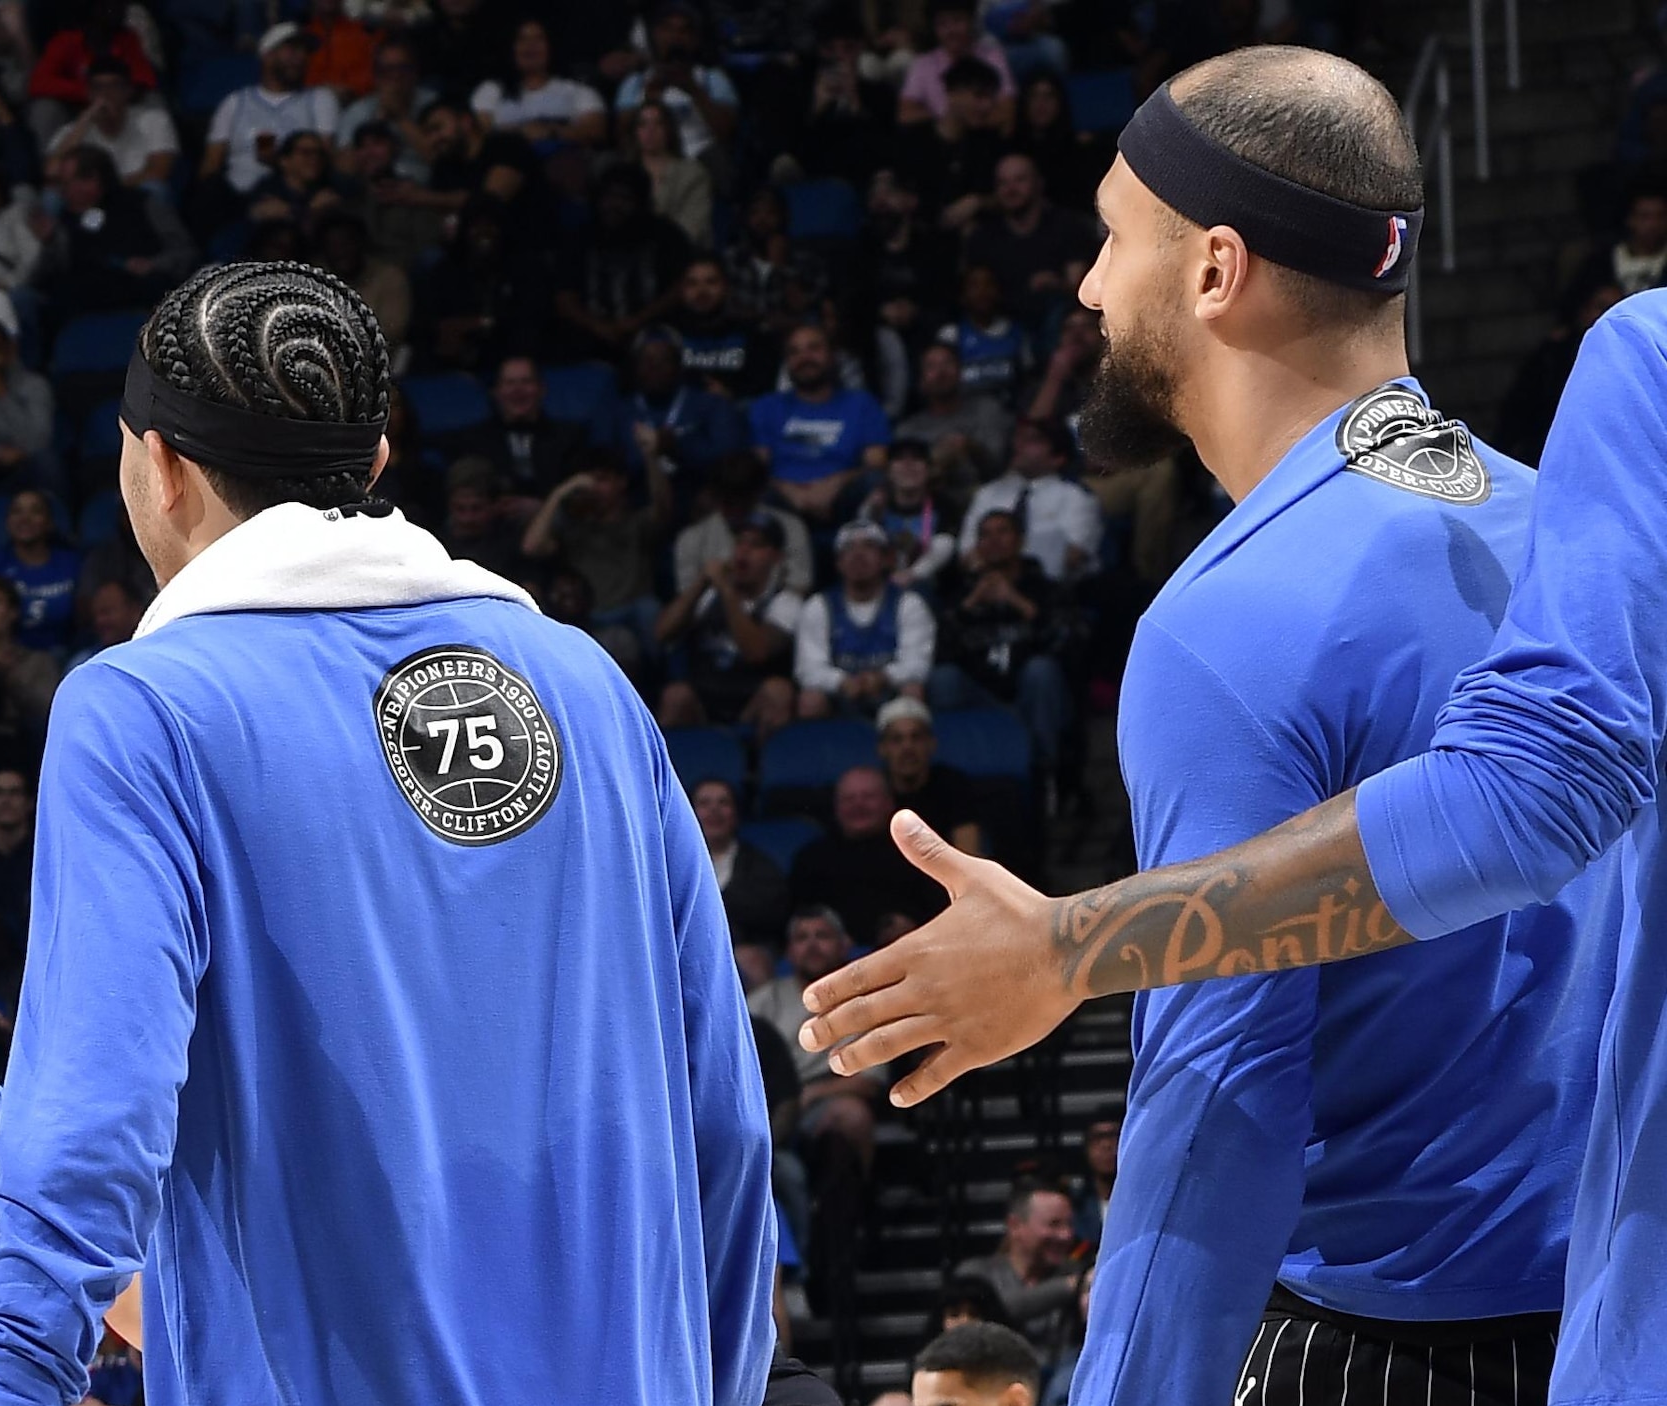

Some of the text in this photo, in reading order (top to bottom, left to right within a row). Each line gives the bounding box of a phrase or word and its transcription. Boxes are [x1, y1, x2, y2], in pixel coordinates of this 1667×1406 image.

[1357, 455, 1478, 495] OPER CLIFTON
[397, 660, 498, 697] PIONEERS
[498, 679, 538, 719] 1950
[426, 714, 505, 775] 75
[528, 730, 552, 796] LLOYD
[387, 739, 435, 817] COOPER
[441, 796, 529, 832] CLIFTON
